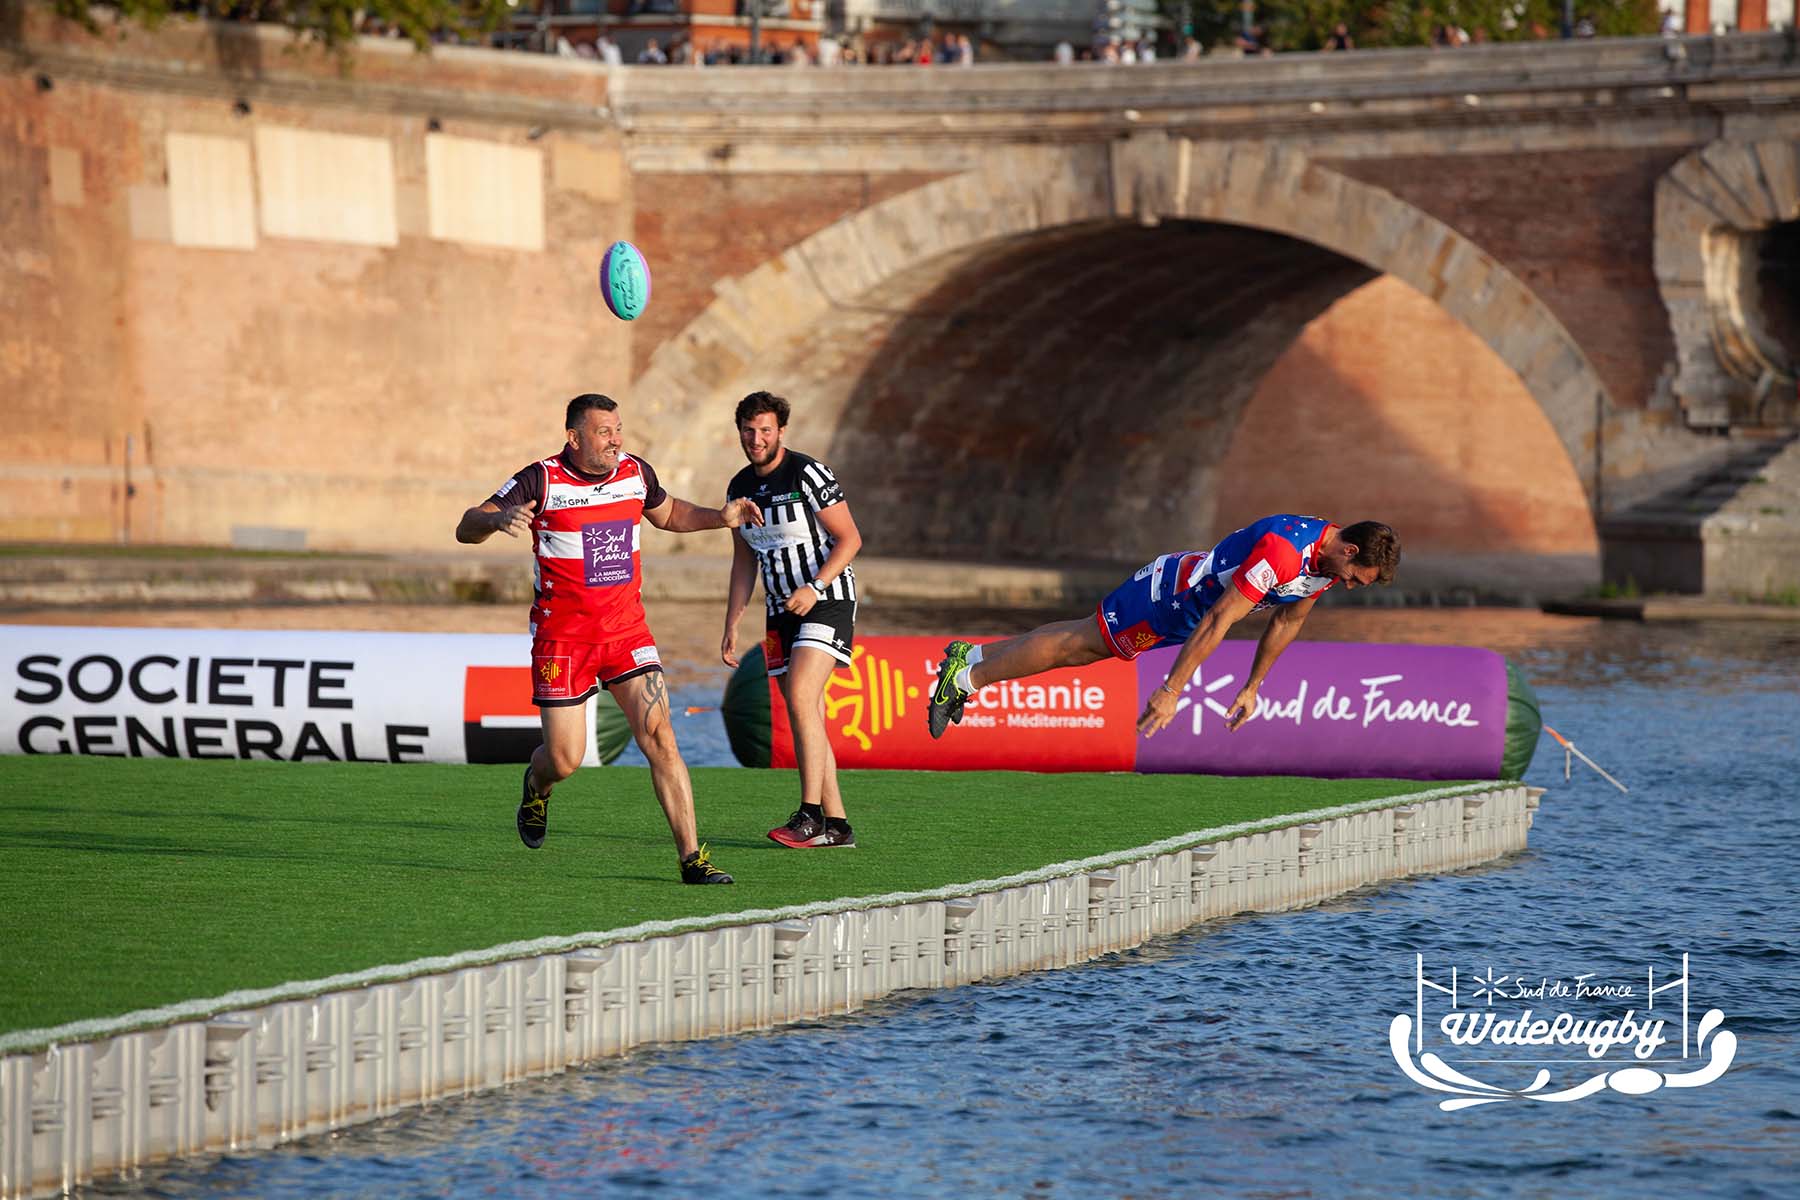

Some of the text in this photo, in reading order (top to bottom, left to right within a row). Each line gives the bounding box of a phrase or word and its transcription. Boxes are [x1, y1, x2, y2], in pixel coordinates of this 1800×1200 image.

[568, 498, 589, 506] GPM
[602, 528, 627, 543] Sud
[592, 546, 631, 568] France
[605, 544, 621, 553] de
[15, 654, 355, 709] SOCIETE
[1312, 686, 1357, 720] de
[1360, 675, 1480, 728] France
[1007, 711, 1104, 728] Méditerranée
[18, 715, 430, 763] GENERALE
